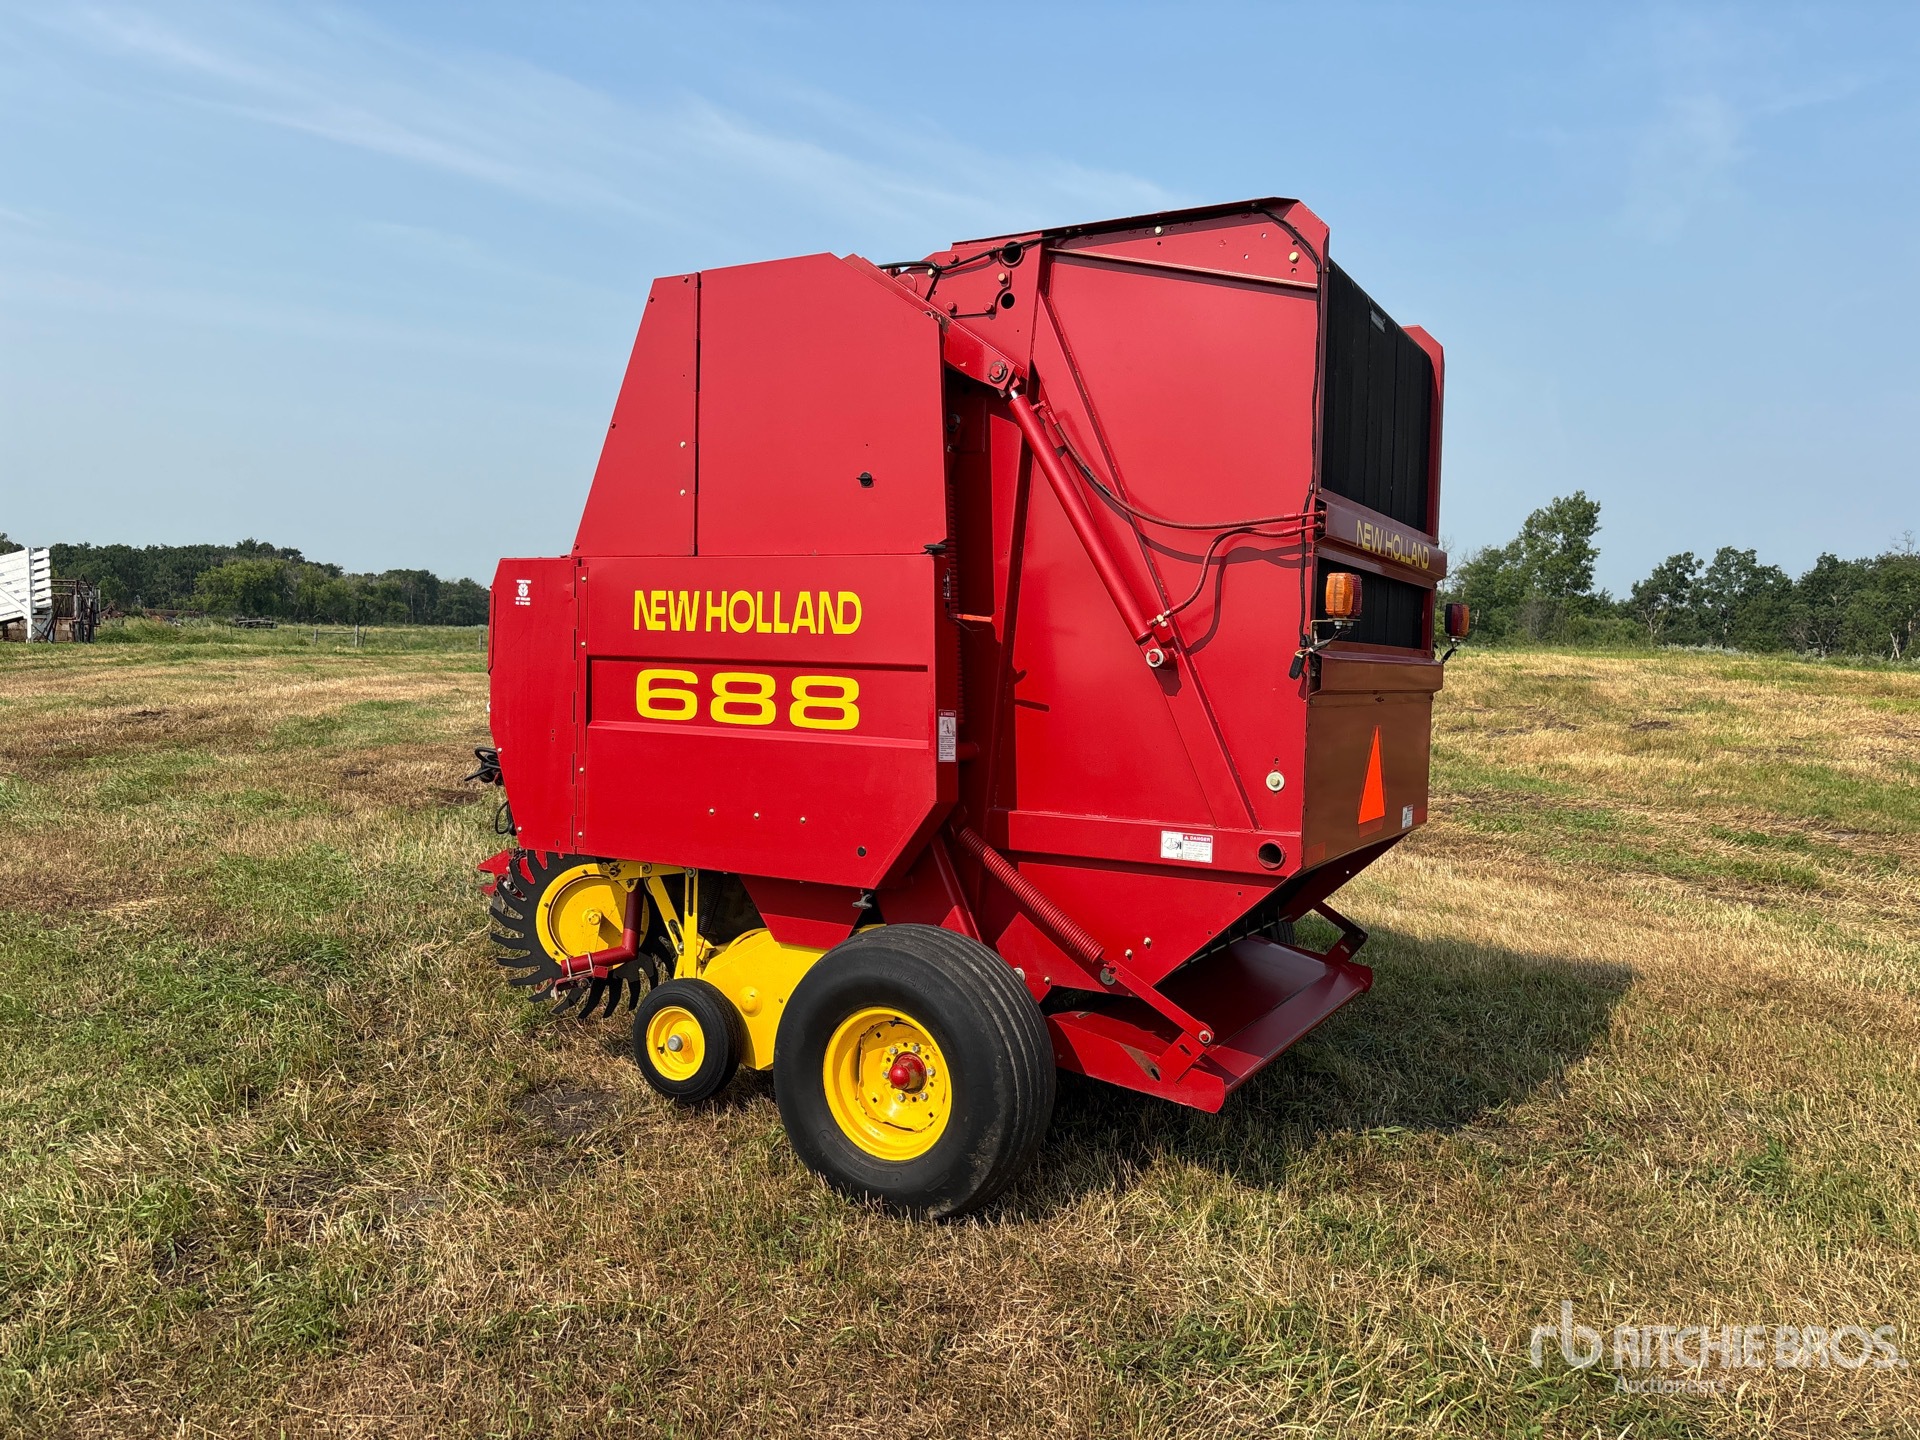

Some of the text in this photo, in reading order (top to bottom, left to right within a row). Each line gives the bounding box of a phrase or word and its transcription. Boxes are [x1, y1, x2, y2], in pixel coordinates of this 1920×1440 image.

[1356, 519, 1430, 569] NEW HOLLAND
[633, 589, 863, 635] NEW HOLLAND
[635, 668, 860, 731] 688
